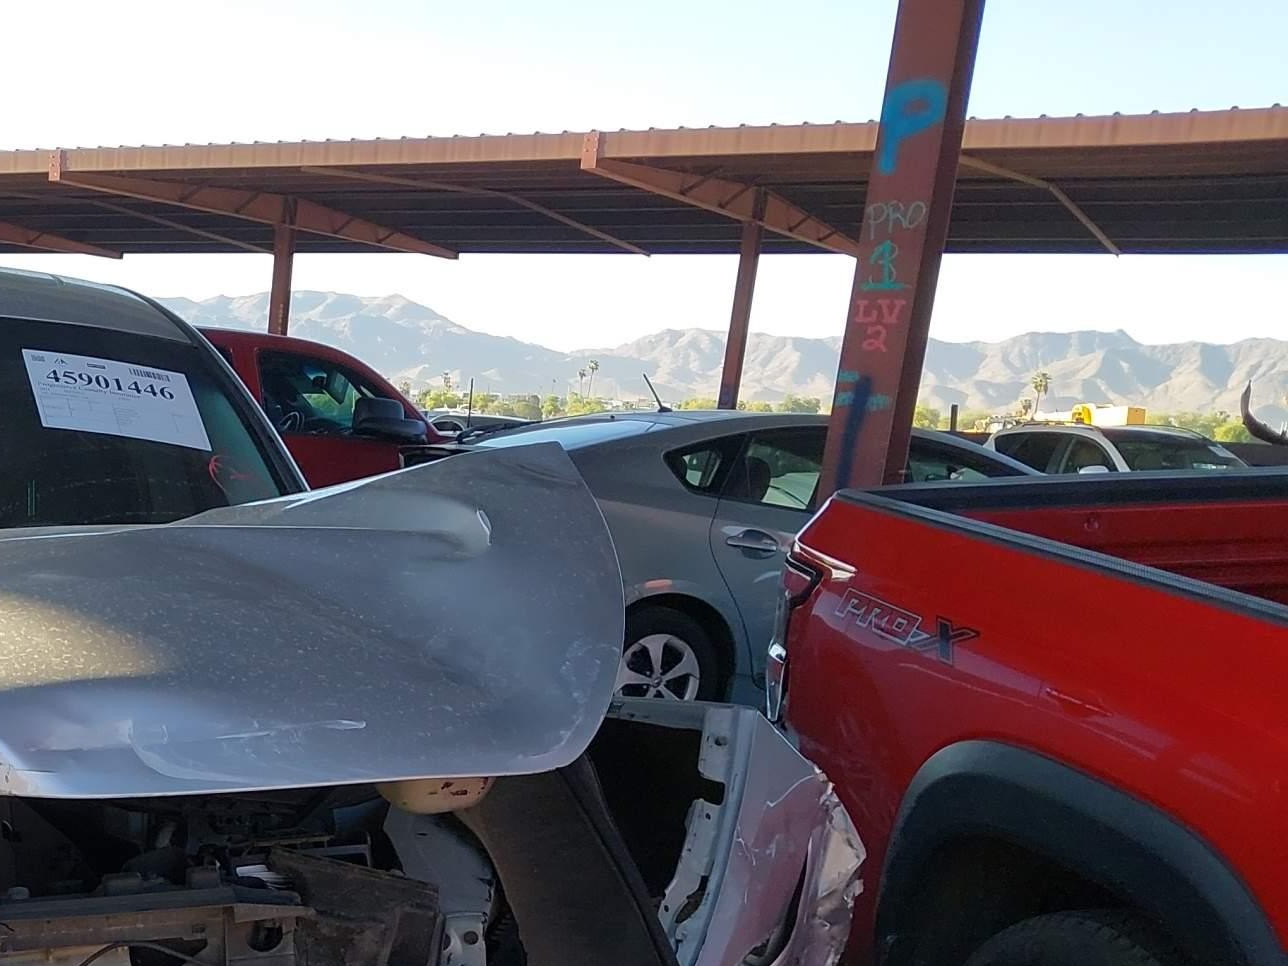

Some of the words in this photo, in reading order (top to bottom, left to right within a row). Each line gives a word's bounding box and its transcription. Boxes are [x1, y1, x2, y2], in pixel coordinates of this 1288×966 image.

[878, 80, 948, 175] P
[866, 201, 927, 240] PRO
[854, 299, 907, 324] LV
[863, 324, 888, 353] 2
[46, 368, 175, 401] 45901446
